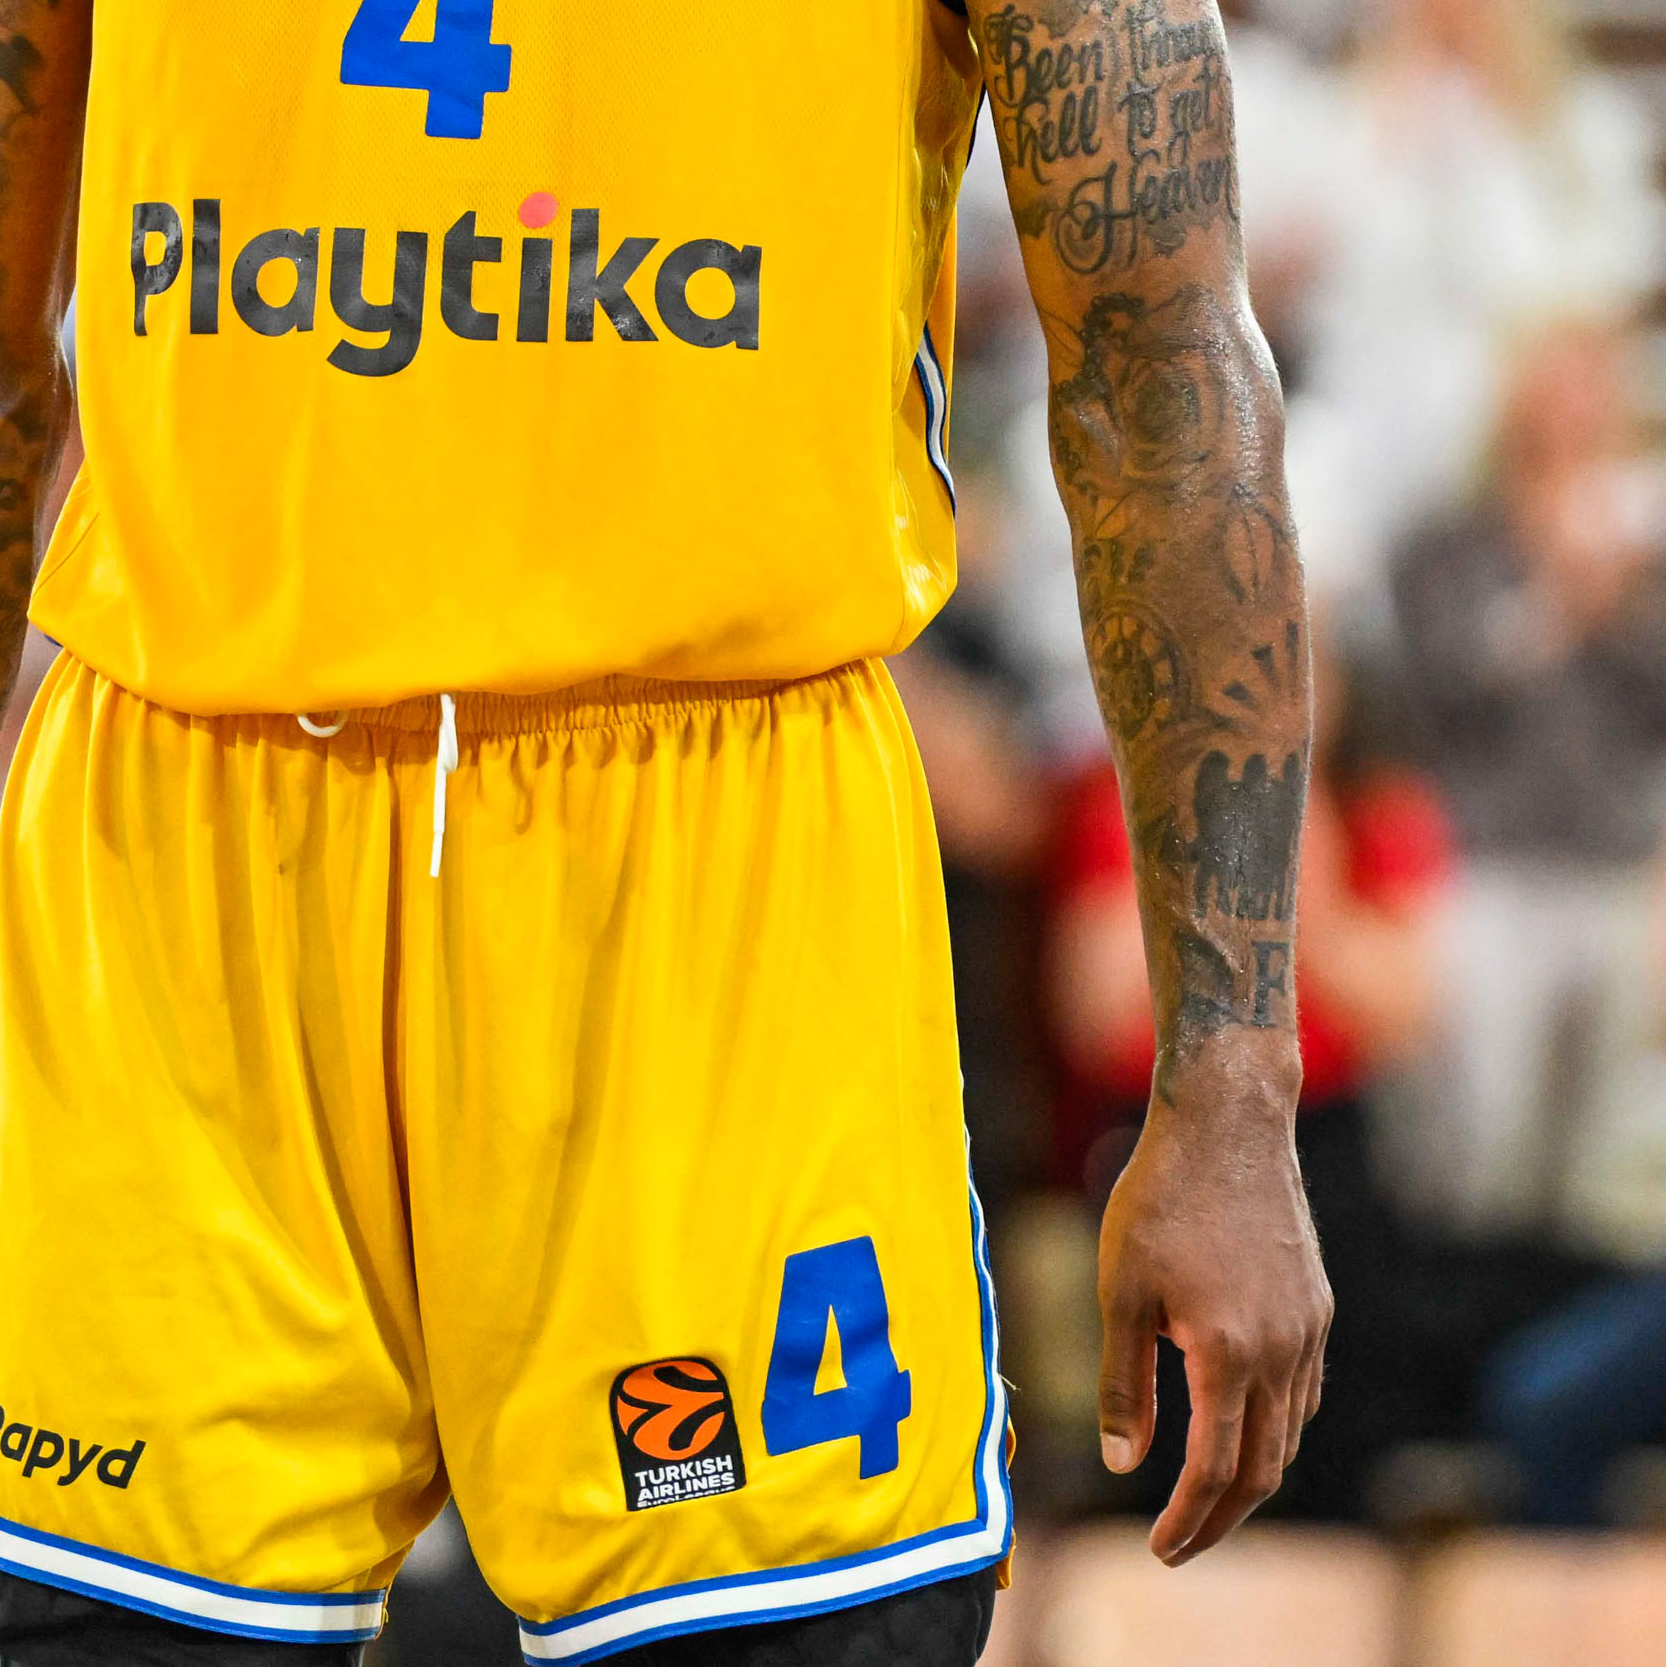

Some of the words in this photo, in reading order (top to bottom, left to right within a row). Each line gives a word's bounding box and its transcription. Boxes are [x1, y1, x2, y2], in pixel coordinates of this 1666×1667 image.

[130, 192, 763, 378] Playtika
[761, 1235, 912, 1479] 4
[634, 1454, 734, 1487] TURKISH
[637, 1472, 736, 1501] AIRLINES
